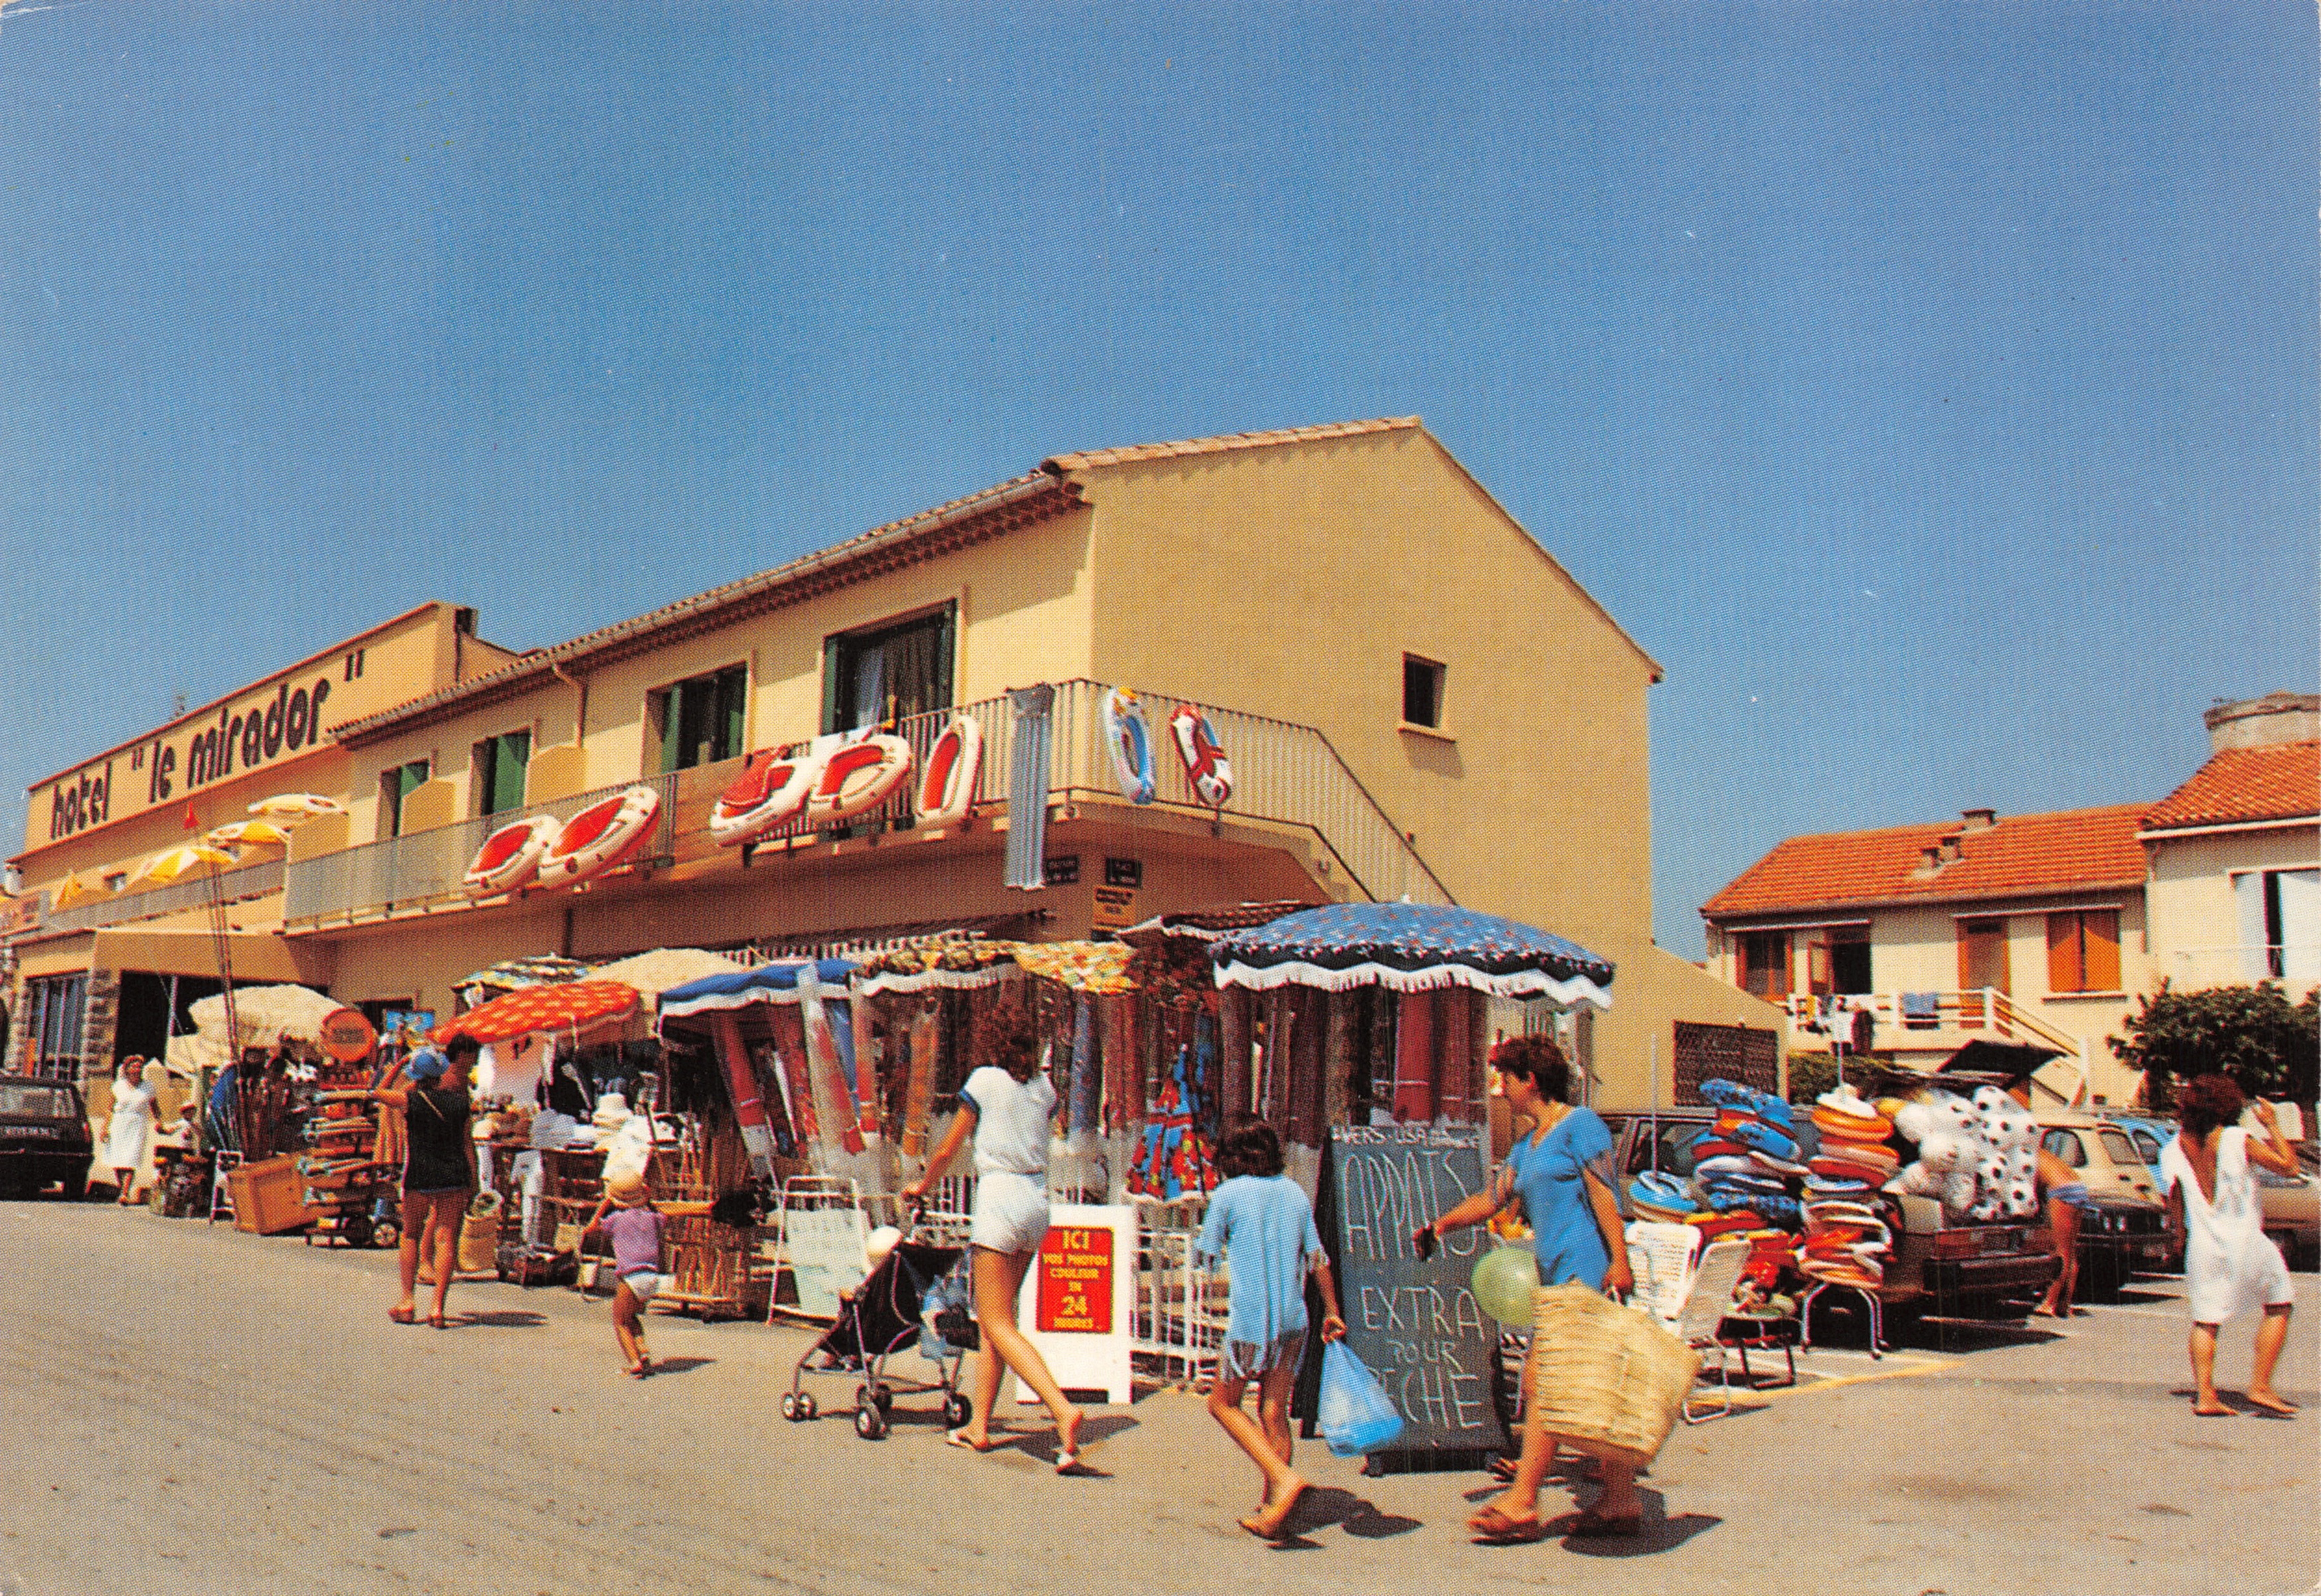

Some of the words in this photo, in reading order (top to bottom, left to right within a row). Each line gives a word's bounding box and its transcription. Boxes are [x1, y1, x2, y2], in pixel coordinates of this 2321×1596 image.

[51, 760, 112, 840] hotel
[1063, 1230, 1089, 1249] ICI
[1066, 1253, 1108, 1266] PHOTOS
[1062, 1295, 1087, 1315] 24
[1361, 1285, 1486, 1342] EXTRA
[1385, 1339, 1464, 1372] POUR
